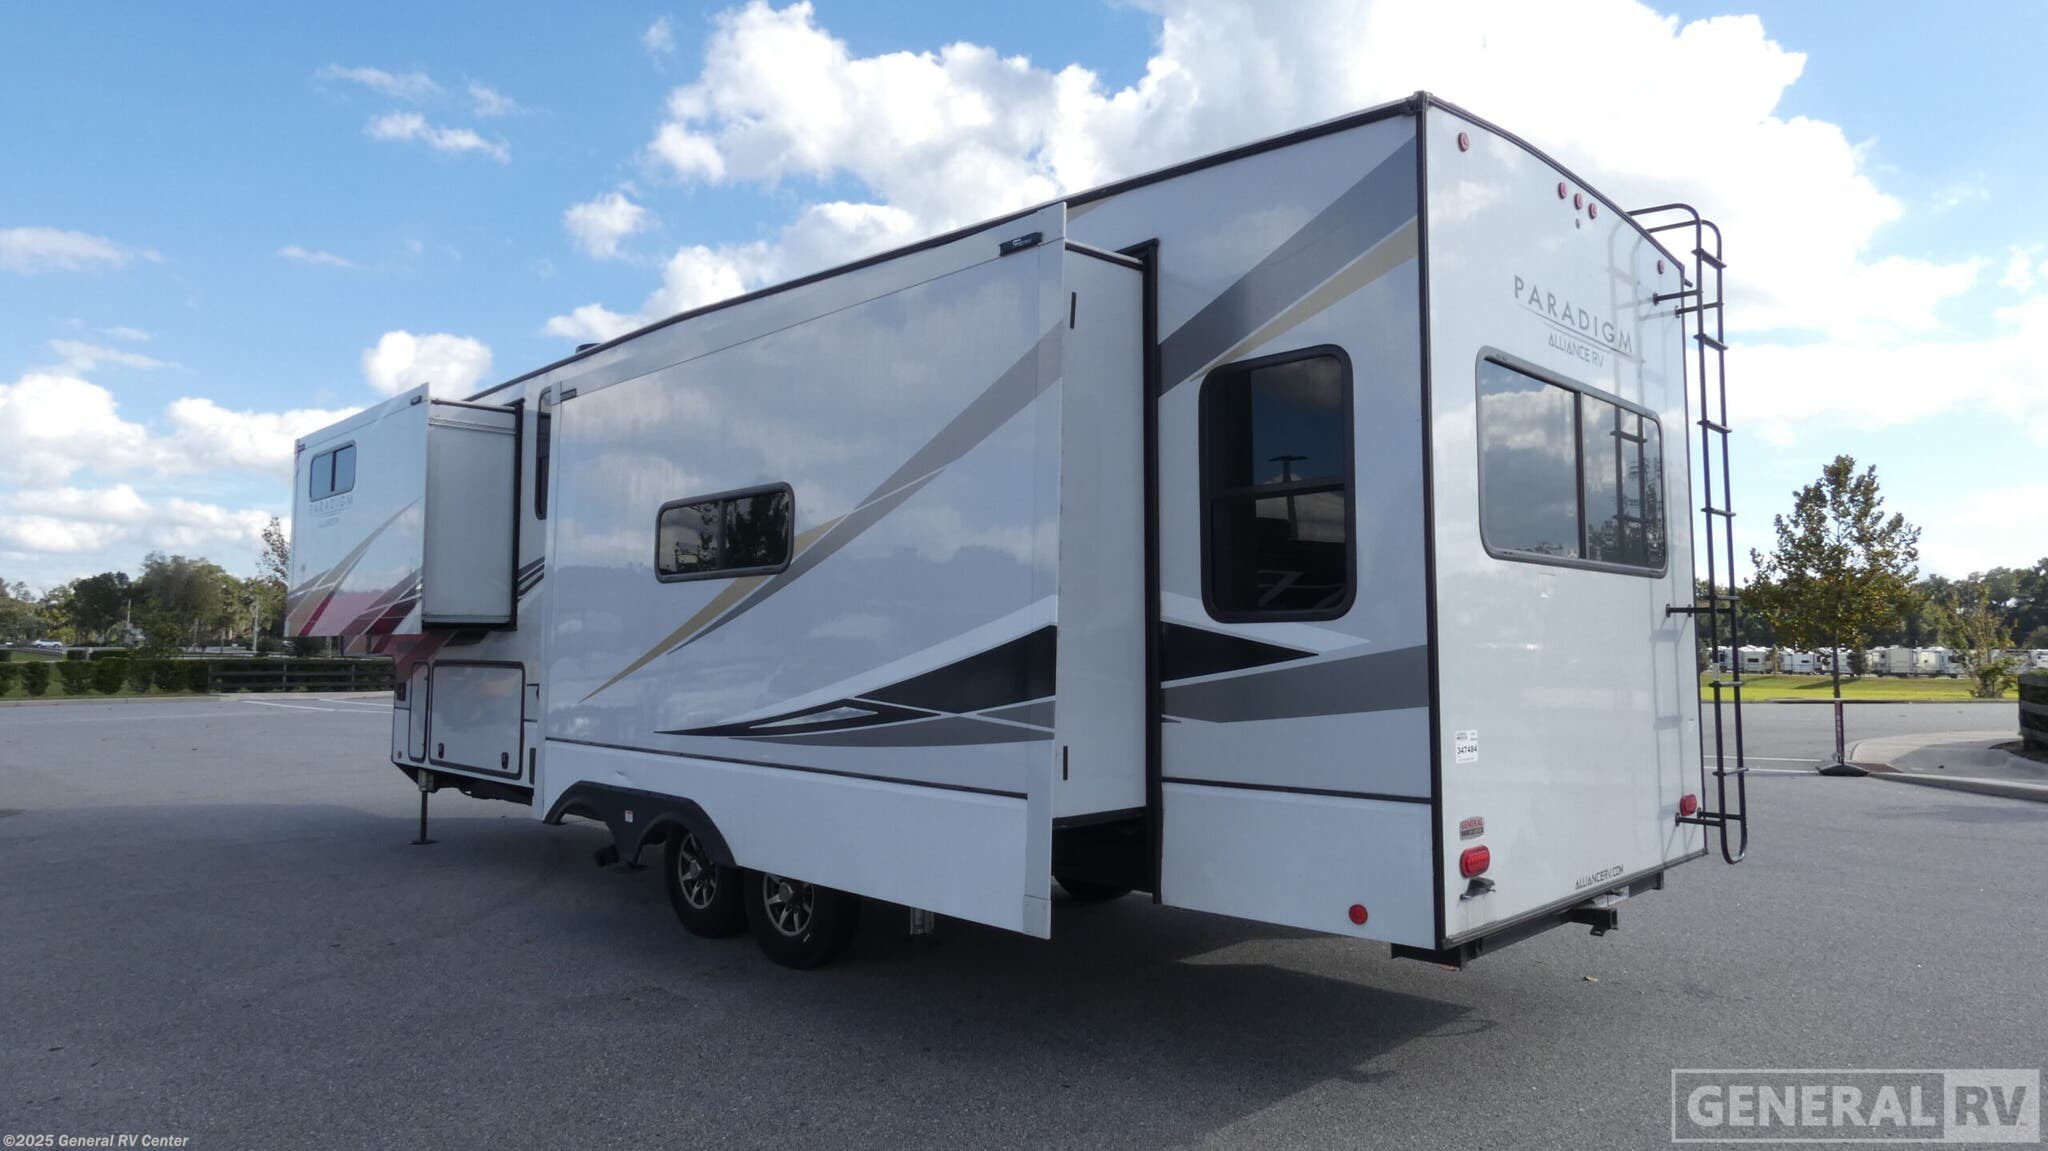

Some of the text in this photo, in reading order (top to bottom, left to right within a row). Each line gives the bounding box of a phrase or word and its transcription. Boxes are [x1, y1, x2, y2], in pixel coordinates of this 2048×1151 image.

[1514, 275, 1632, 353] PARADIGM
[1548, 333, 1604, 367] ALLIANCE RV
